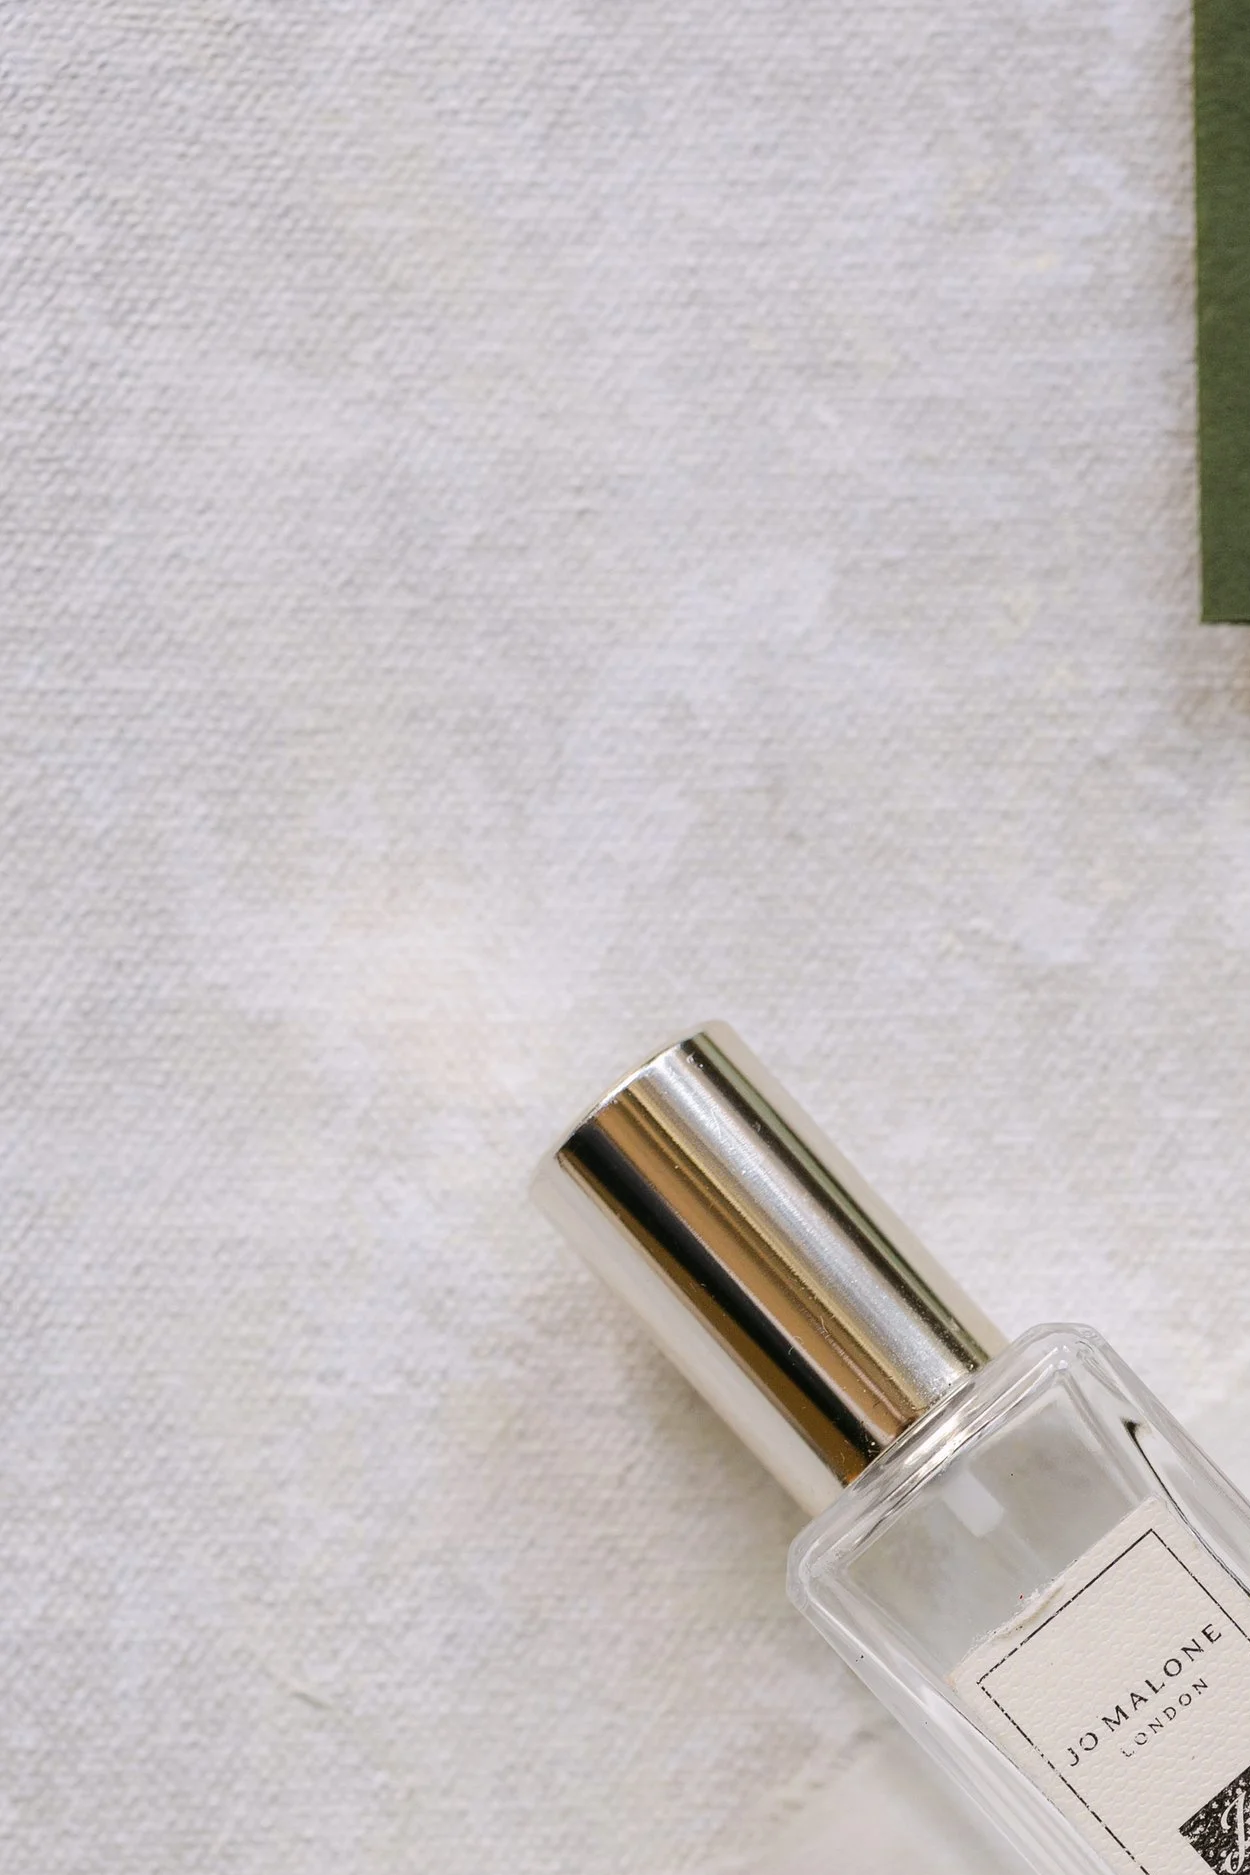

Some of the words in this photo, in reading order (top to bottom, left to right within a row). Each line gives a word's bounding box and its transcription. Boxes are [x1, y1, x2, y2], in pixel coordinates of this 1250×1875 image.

[1066, 1731, 1099, 1768] JO
[1101, 1623, 1222, 1732] MALONE
[1120, 1678, 1208, 1758] LONDON
